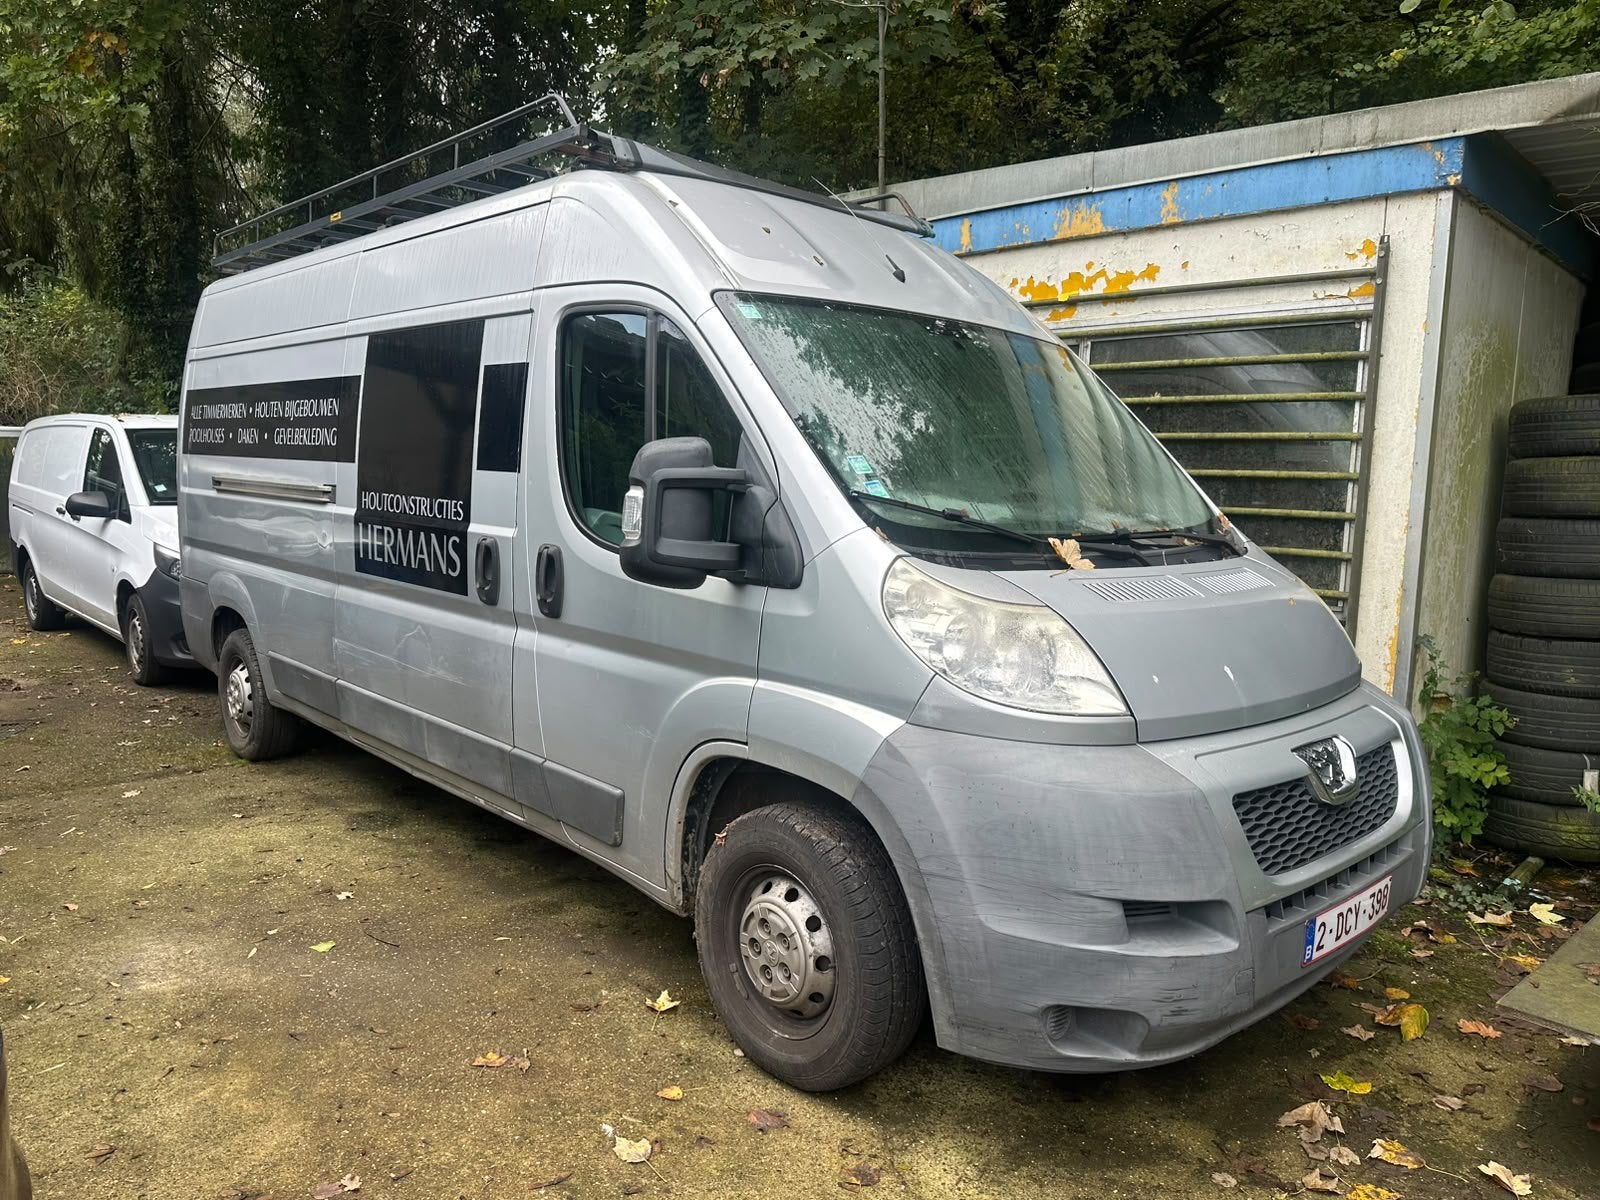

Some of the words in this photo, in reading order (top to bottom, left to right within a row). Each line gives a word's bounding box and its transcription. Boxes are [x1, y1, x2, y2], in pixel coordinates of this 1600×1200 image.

[190, 405, 202, 419] ALLE
[202, 403, 247, 419] TIMMERWERKEN
[254, 401, 284, 418] HOUTEN
[284, 398, 340, 421] BIJGEBOUWEN
[237, 427, 260, 444] DAKEN
[274, 427, 338, 446] GEVELBEKLEDING
[361, 491, 465, 521] HOUTCONSTRUCTIES
[358, 522, 462, 577] HERMANS
[1304, 944, 1313, 962] B
